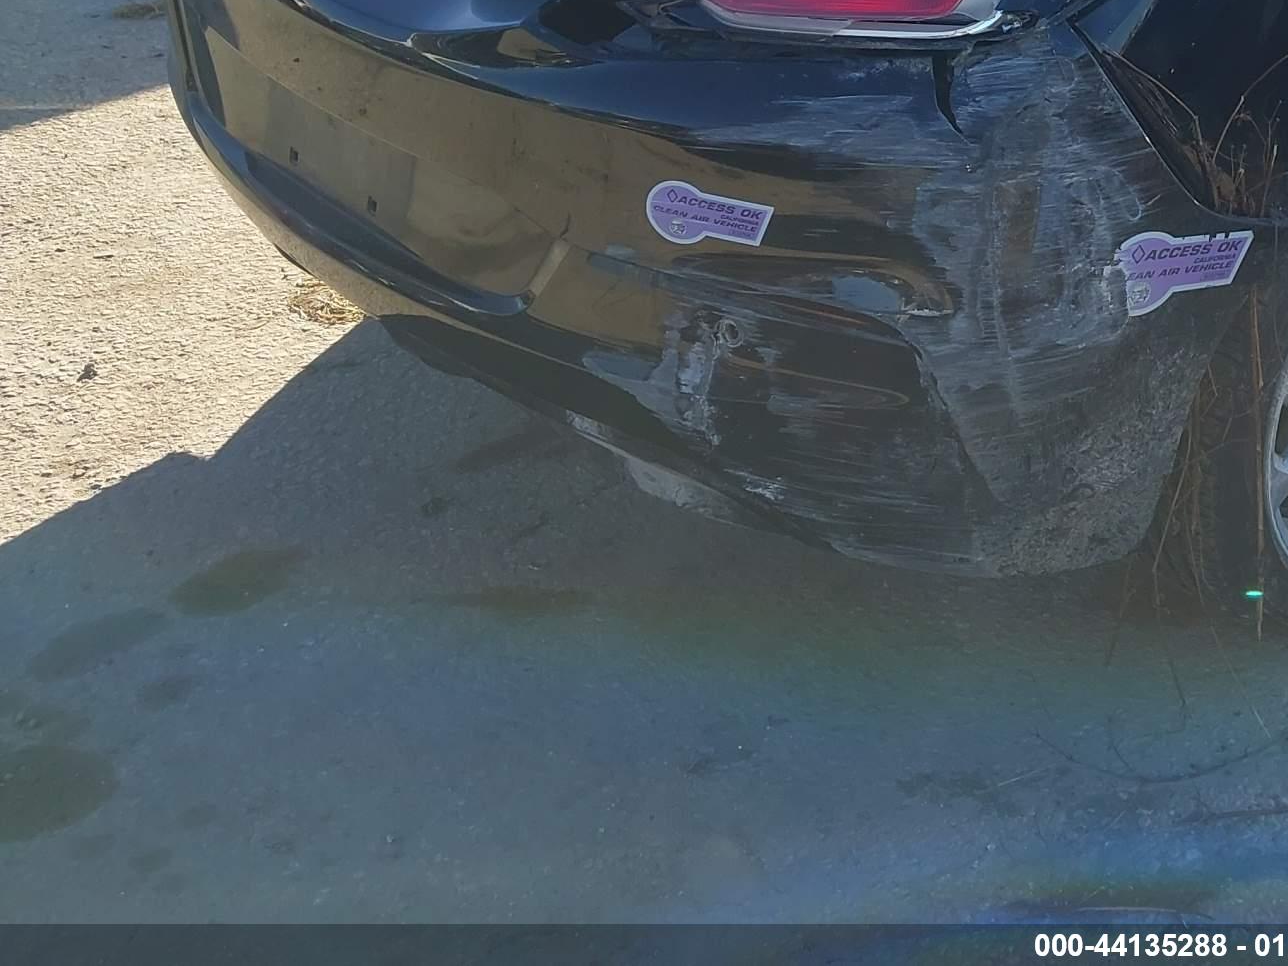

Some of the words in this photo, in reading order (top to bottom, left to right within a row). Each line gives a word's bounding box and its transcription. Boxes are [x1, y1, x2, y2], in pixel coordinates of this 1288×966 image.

[653, 204, 688, 218] CLEAN
[690, 213, 710, 223] AIR
[713, 218, 759, 233] VEHICLE
[676, 195, 737, 215] ACCESS
[740, 208, 763, 220] OK
[1144, 242, 1213, 261] ACCESS
[1216, 239, 1243, 253] OK
[1159, 266, 1181, 278] AIR
[1184, 259, 1234, 274] VEHICLE
